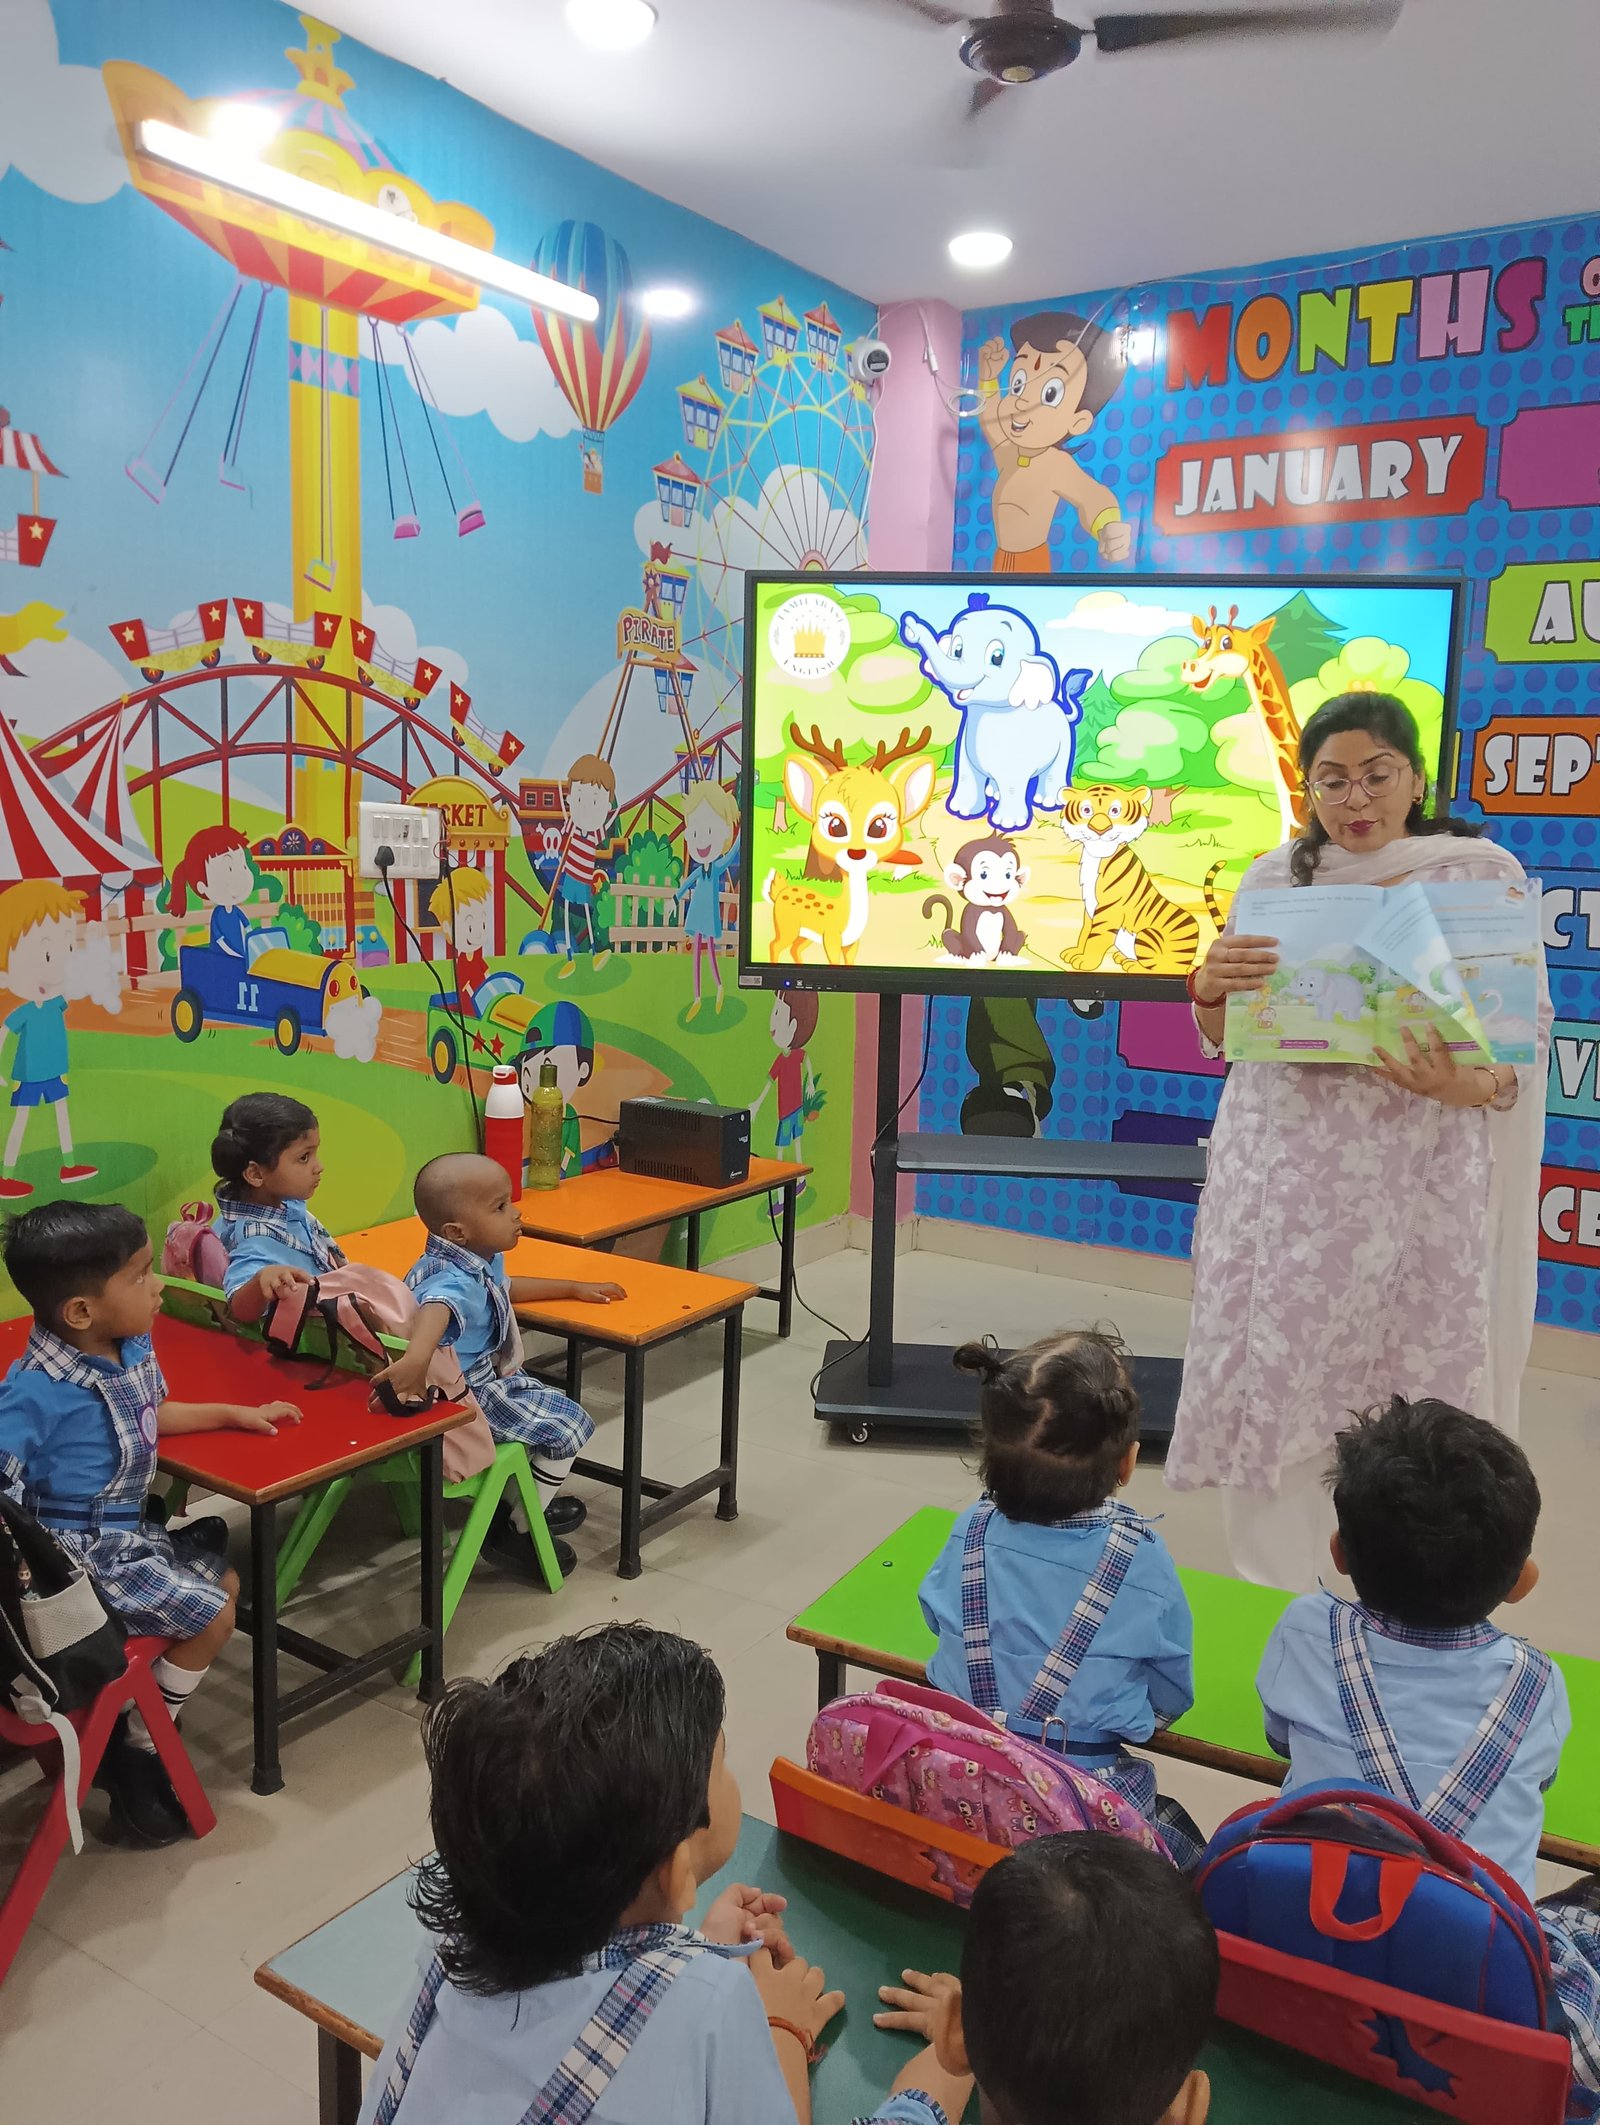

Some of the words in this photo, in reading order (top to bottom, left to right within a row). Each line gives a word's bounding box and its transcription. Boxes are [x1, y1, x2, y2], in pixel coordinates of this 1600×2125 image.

[1165, 255, 1547, 393] MONTHS
[1173, 434, 1465, 518] JANUARY
[621, 613, 676, 653] PIRATE
[1483, 731, 1600, 796] SEP
[414, 802, 488, 827] CKET
